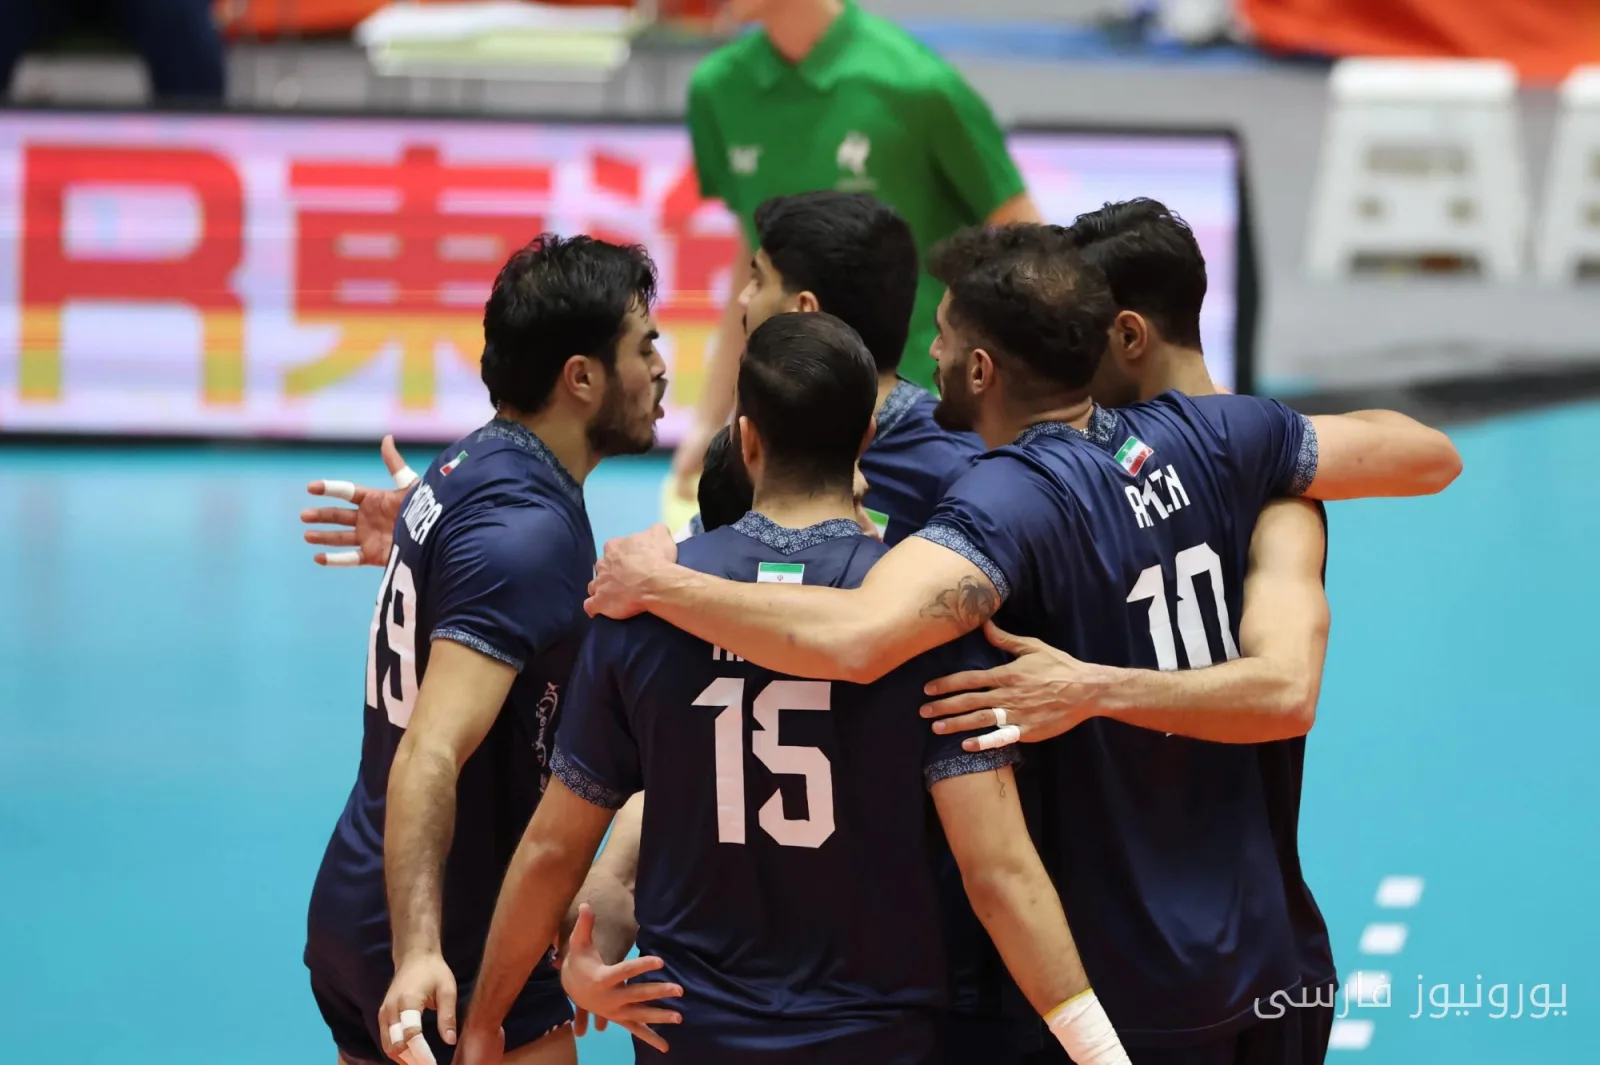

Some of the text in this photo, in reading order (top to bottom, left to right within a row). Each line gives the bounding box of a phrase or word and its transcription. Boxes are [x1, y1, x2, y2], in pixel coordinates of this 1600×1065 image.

[366, 544, 421, 730] 19
[1126, 541, 1241, 672] 10
[690, 676, 836, 849] 15
